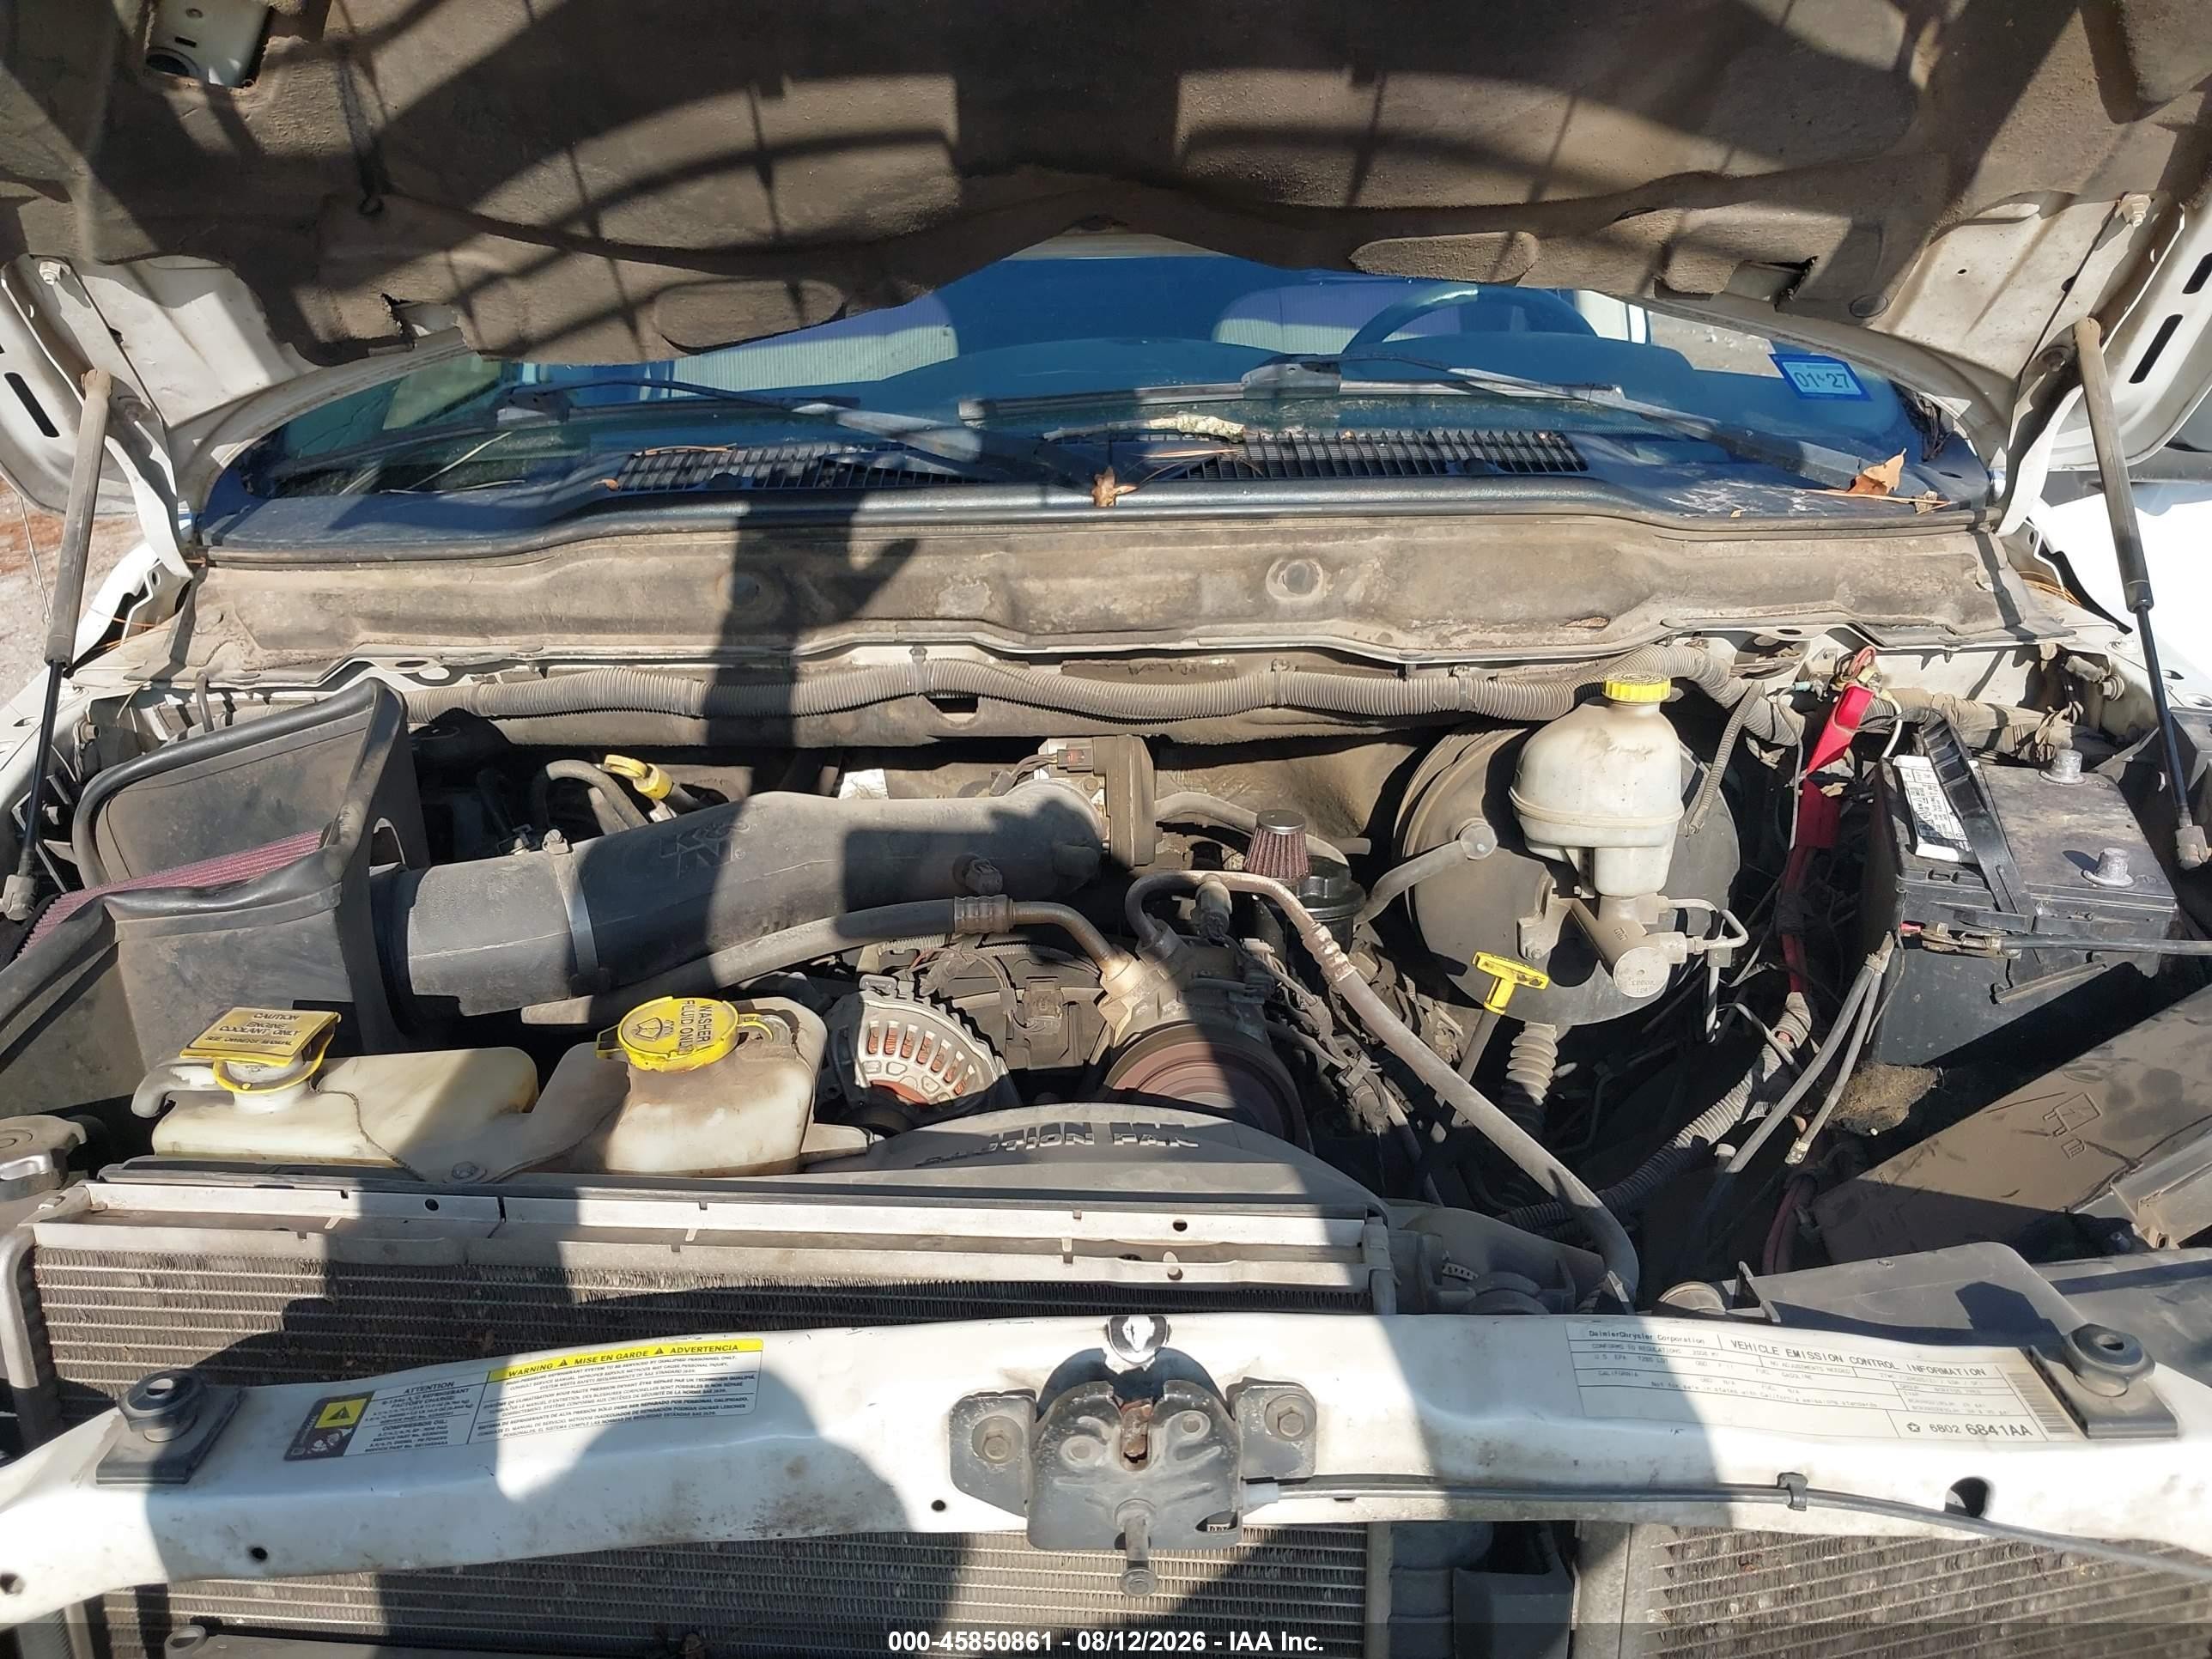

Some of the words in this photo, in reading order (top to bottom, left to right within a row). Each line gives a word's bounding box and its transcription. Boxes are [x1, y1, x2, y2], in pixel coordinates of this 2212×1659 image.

[1794, 372, 1820, 387] 01
[1826, 373, 1850, 388] 27
[253, 1012, 301, 1021] CAUTION
[679, 1000, 696, 1027] FLUID
[219, 1025, 271, 1036] COOLANT
[246, 1021, 288, 1030] ENGINE
[696, 1003, 713, 1043] WASHER
[1589, 1330, 1654, 1340] DaimlerChrysler
[1657, 1334, 1705, 1345] Corporation
[508, 1363, 554, 1377] WARNING
[574, 1354, 599, 1365] MISE
[601, 1352, 613, 1361] EN
[615, 1350, 650, 1360] GARDE
[670, 1344, 739, 1354] ADVERTENCIA
[1731, 1340, 1780, 1356] VEHICLE
[1785, 1349, 1844, 1363] EMISSION
[1849, 1356, 1900, 1370] CONTROL
[1906, 1364, 1987, 1376] INFORMATION
[404, 1381, 455, 1395] ATTENTION
[1929, 1423, 1962, 1434] 6802
[1965, 1424, 2033, 1437] 6841AA
